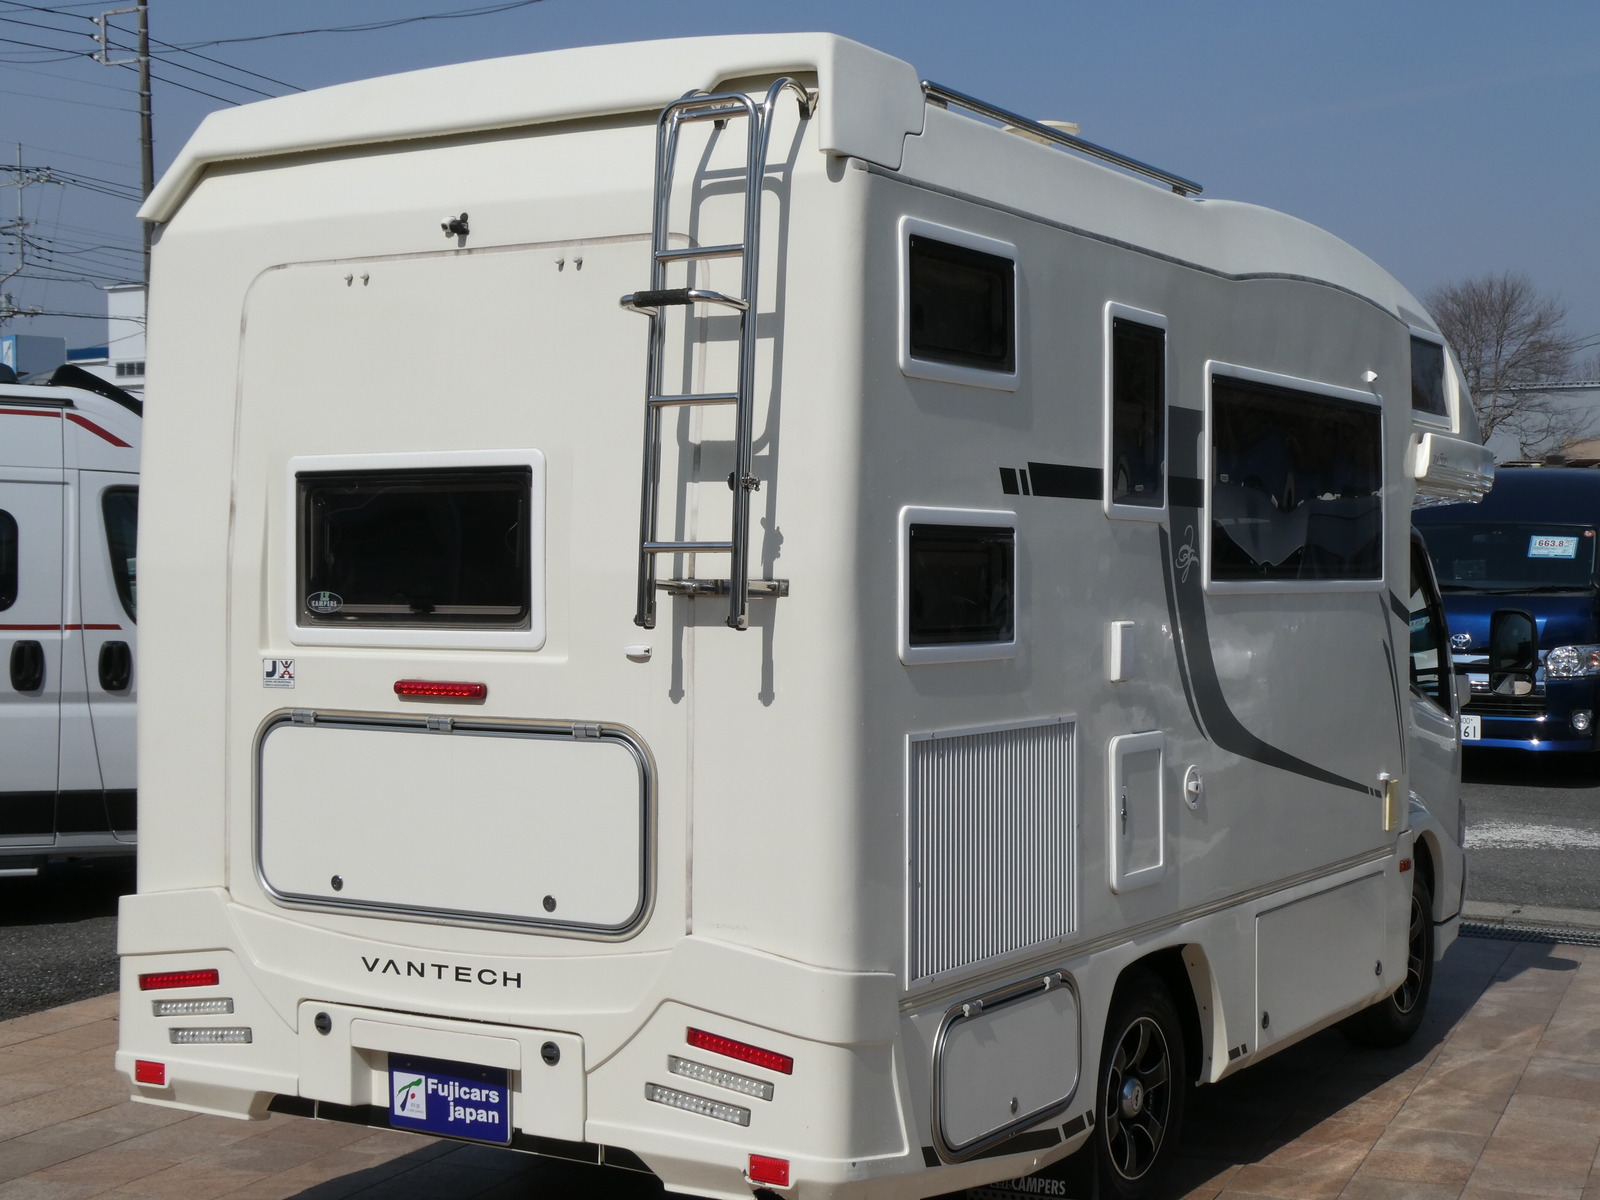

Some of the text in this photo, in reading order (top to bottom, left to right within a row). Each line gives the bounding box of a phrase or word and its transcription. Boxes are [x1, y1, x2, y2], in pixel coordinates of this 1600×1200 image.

[1538, 540, 1565, 548] 663.8
[361, 956, 522, 989] VANTECH
[427, 1078, 500, 1104] Fujicars
[448, 1102, 500, 1124] japan
